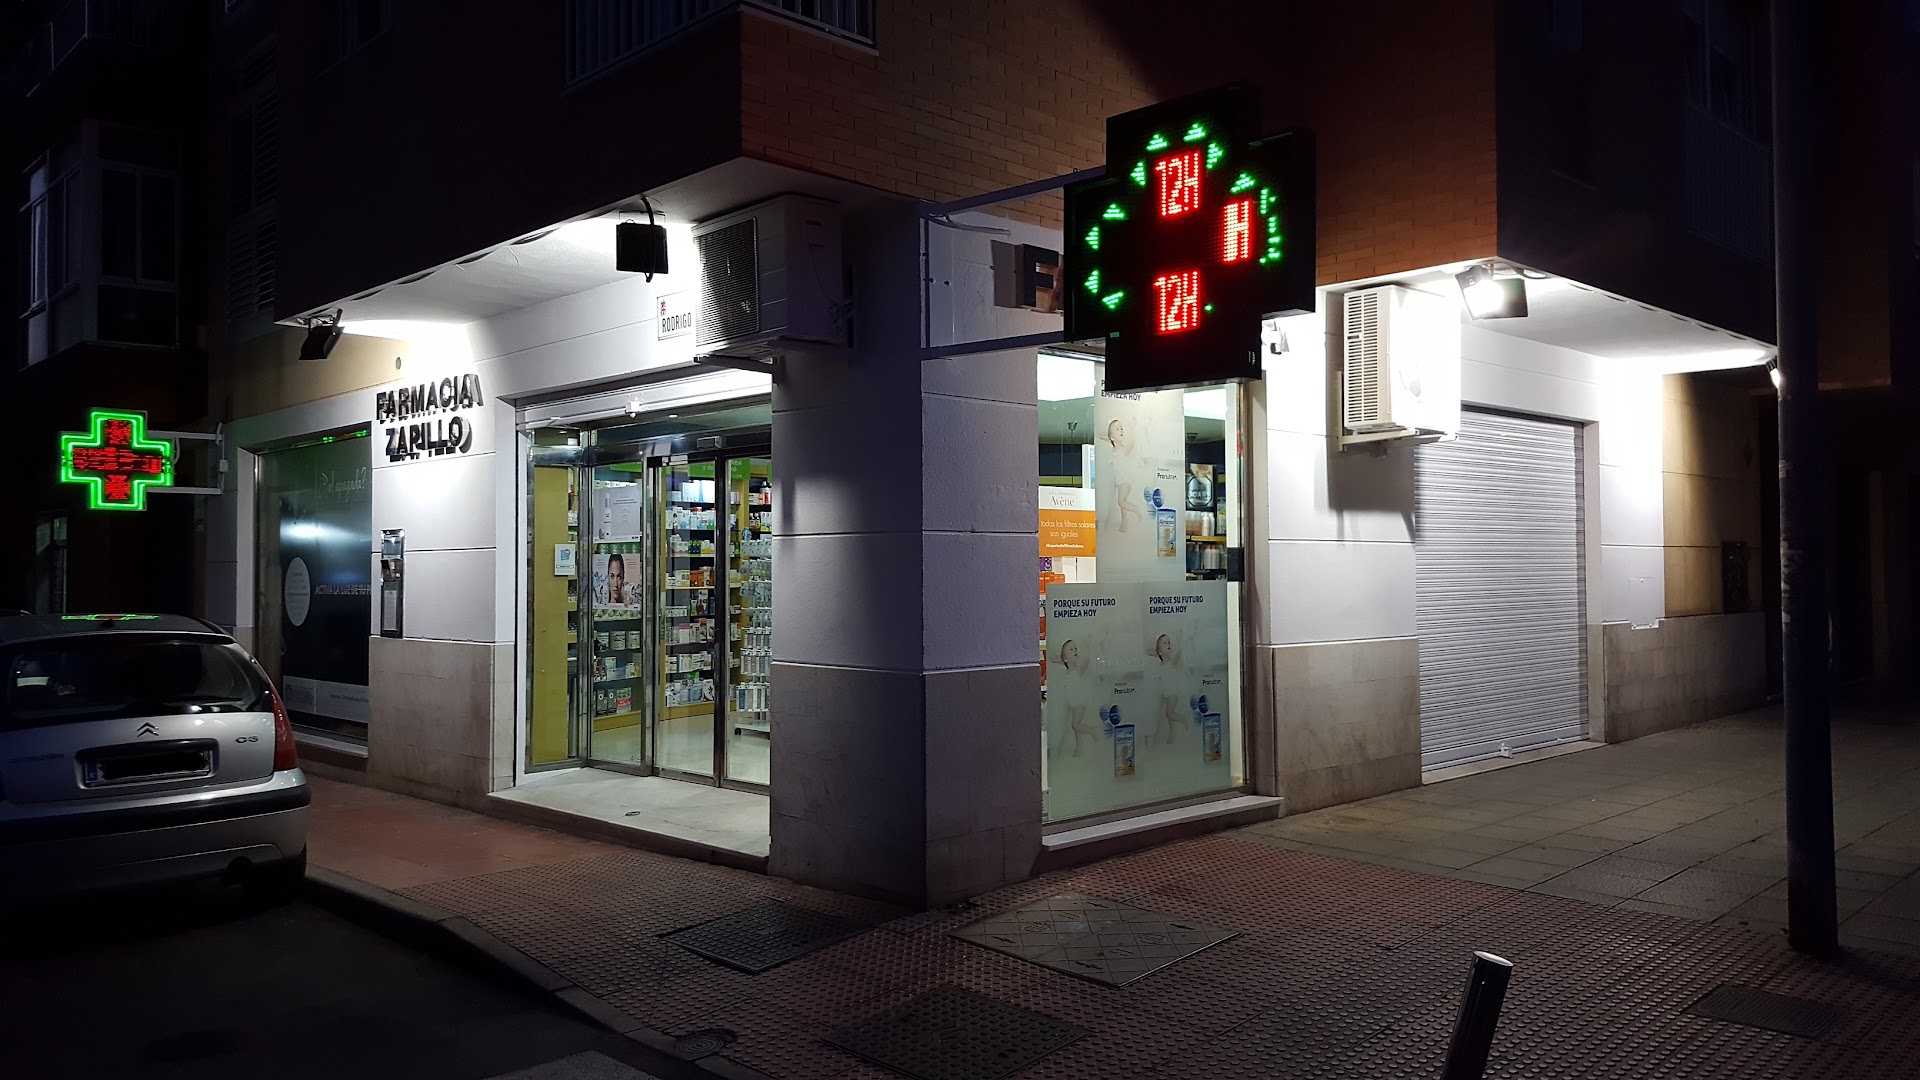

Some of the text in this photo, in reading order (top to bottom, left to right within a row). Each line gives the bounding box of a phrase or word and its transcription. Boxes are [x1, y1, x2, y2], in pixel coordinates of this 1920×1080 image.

[1155, 152, 1200, 217] 12H
[1154, 270, 1198, 332] 12H
[661, 312, 692, 334] RODRIGO
[376, 373, 482, 421] FARMACIA
[385, 416, 468, 458] ZAPILLO
[1050, 495, 1075, 506] Avène
[1040, 519, 1056, 528] todos
[1056, 520, 1064, 528] los
[1053, 598, 1116, 609] PORQUE SU FUTURO
[1149, 595, 1204, 605] PORQUE SU FUTURO
[1053, 609, 1097, 618] EMPIEZA HOY
[1149, 605, 1187, 614] EMPIEZA HOY
